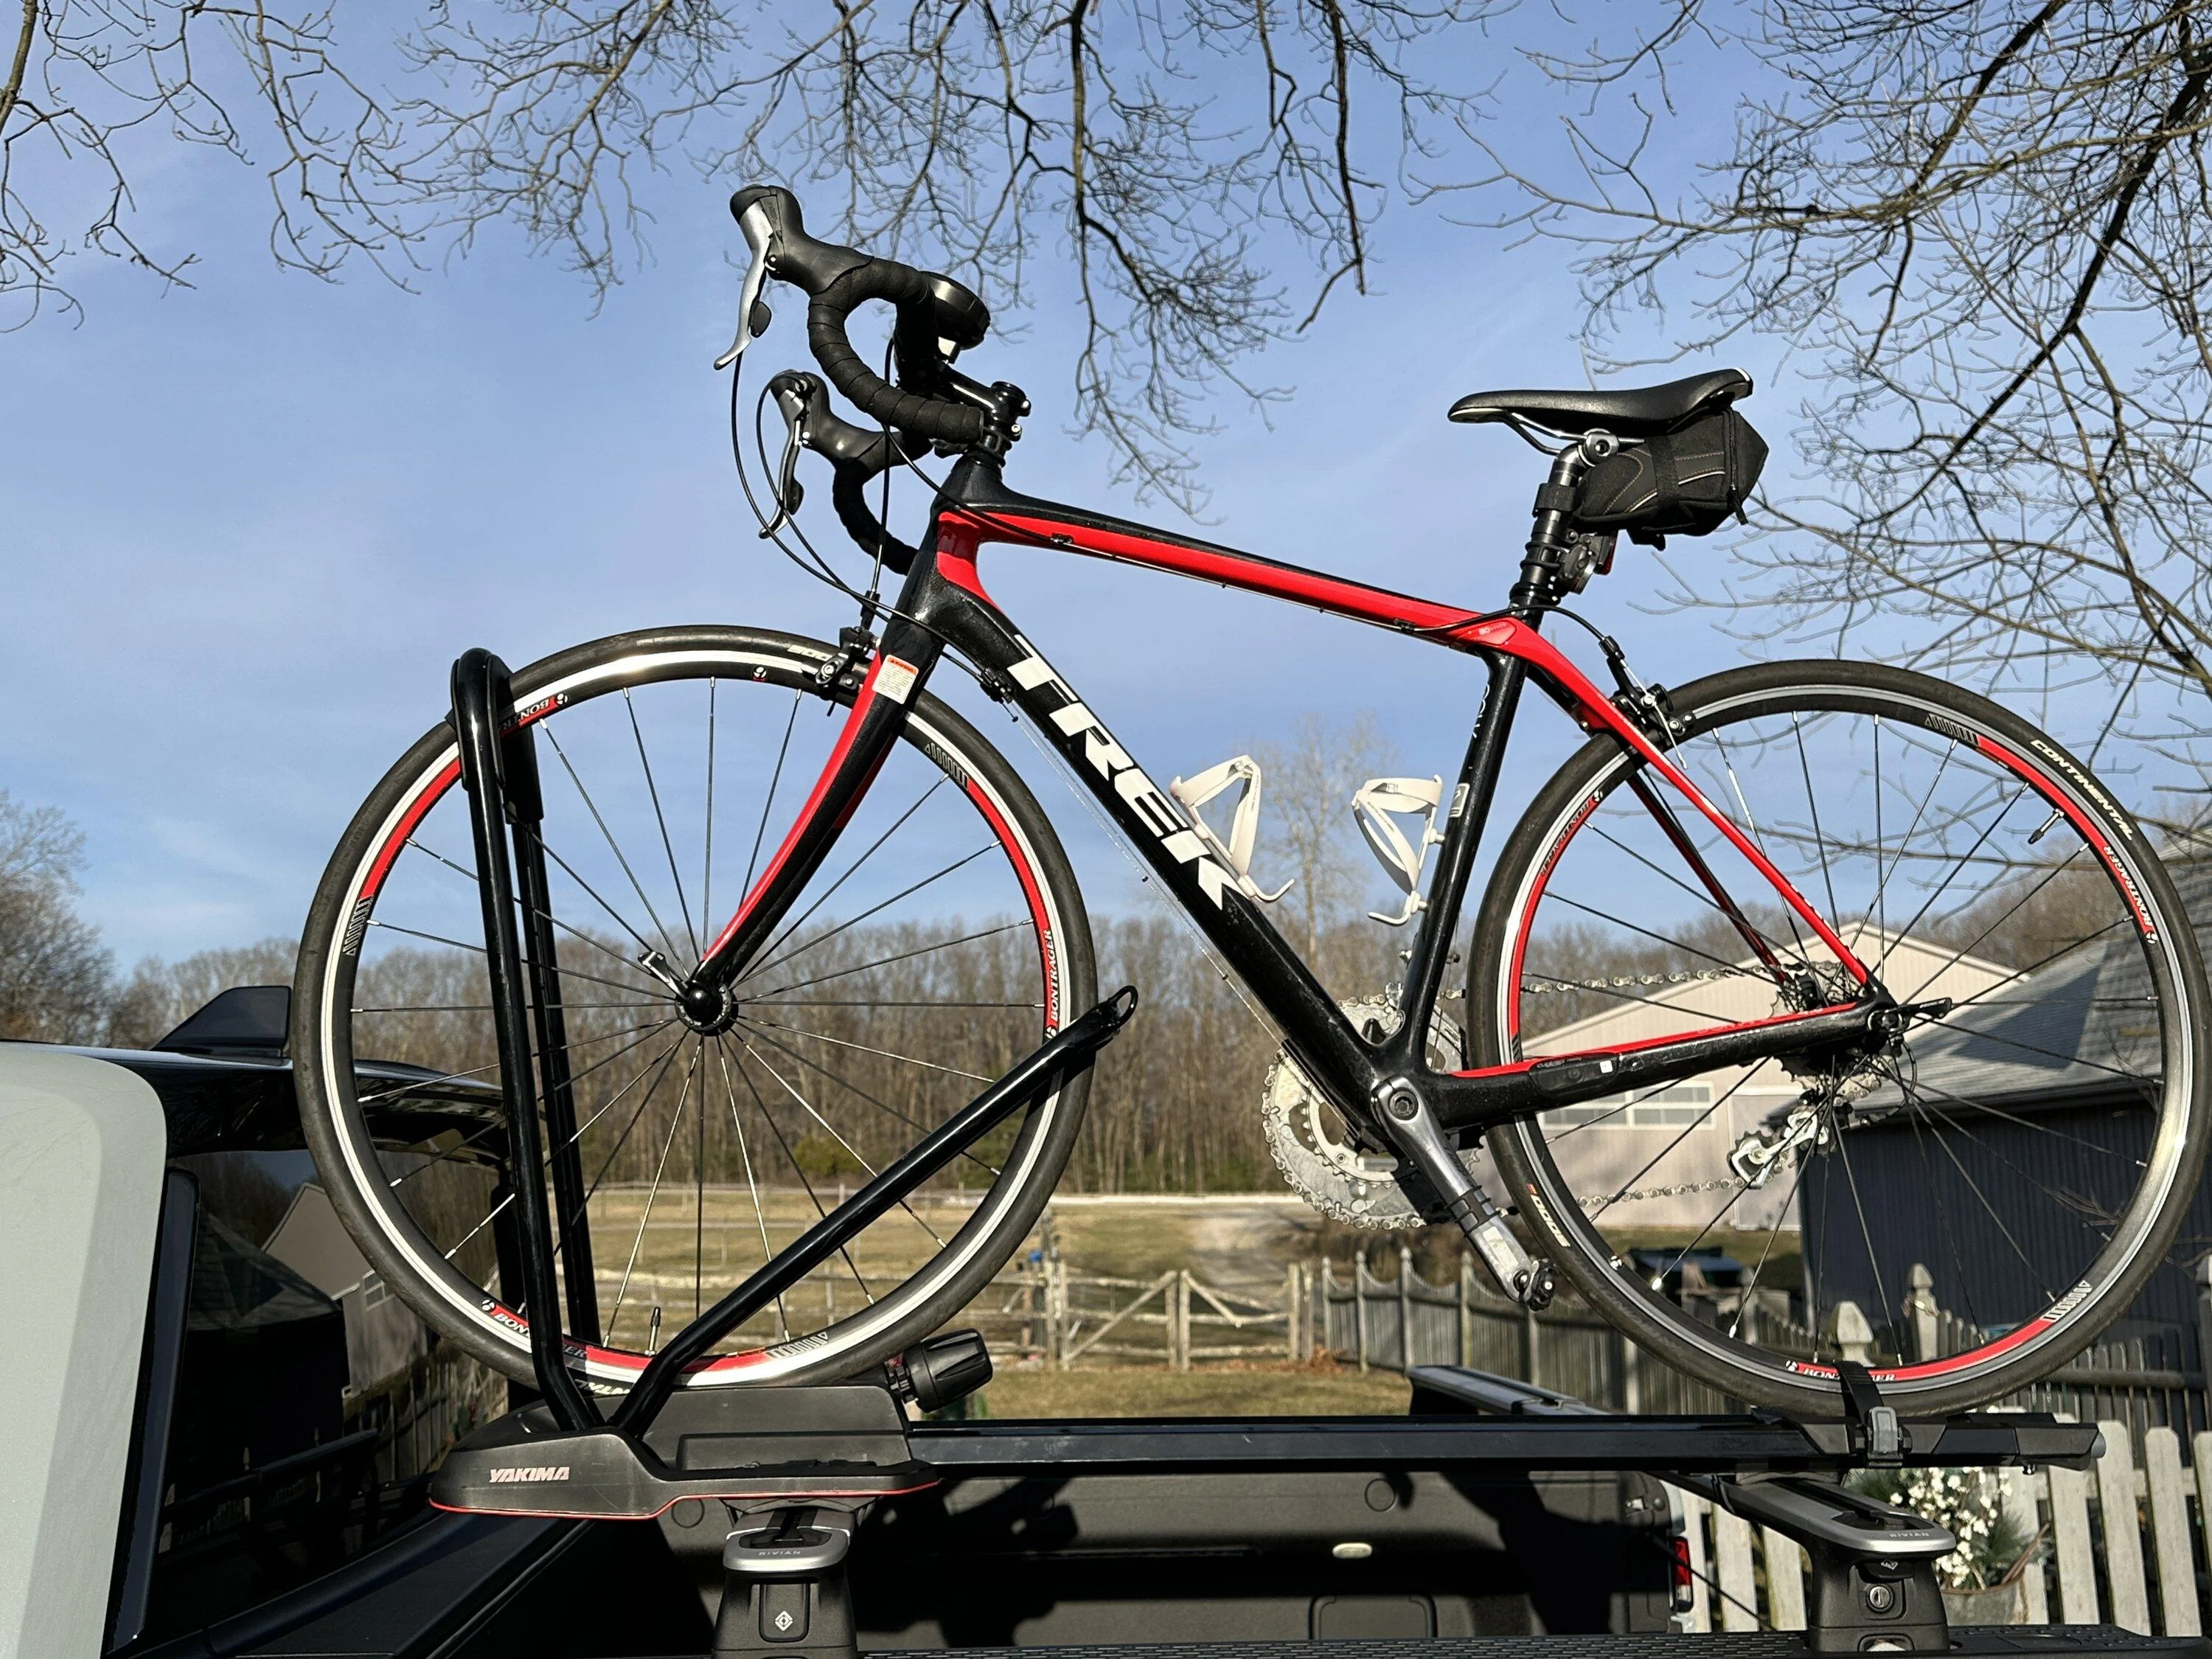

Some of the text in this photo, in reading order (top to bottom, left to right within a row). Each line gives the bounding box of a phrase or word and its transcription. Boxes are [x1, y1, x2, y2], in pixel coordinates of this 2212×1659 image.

[1006, 634, 1252, 911] TREK
[2031, 740, 2133, 841] CONTINENTAL
[2103, 846, 2154, 927] BONTRAGER
[1043, 929, 1059, 1022] BONTRAGER
[489, 1467, 570, 1483] YAKIMA
